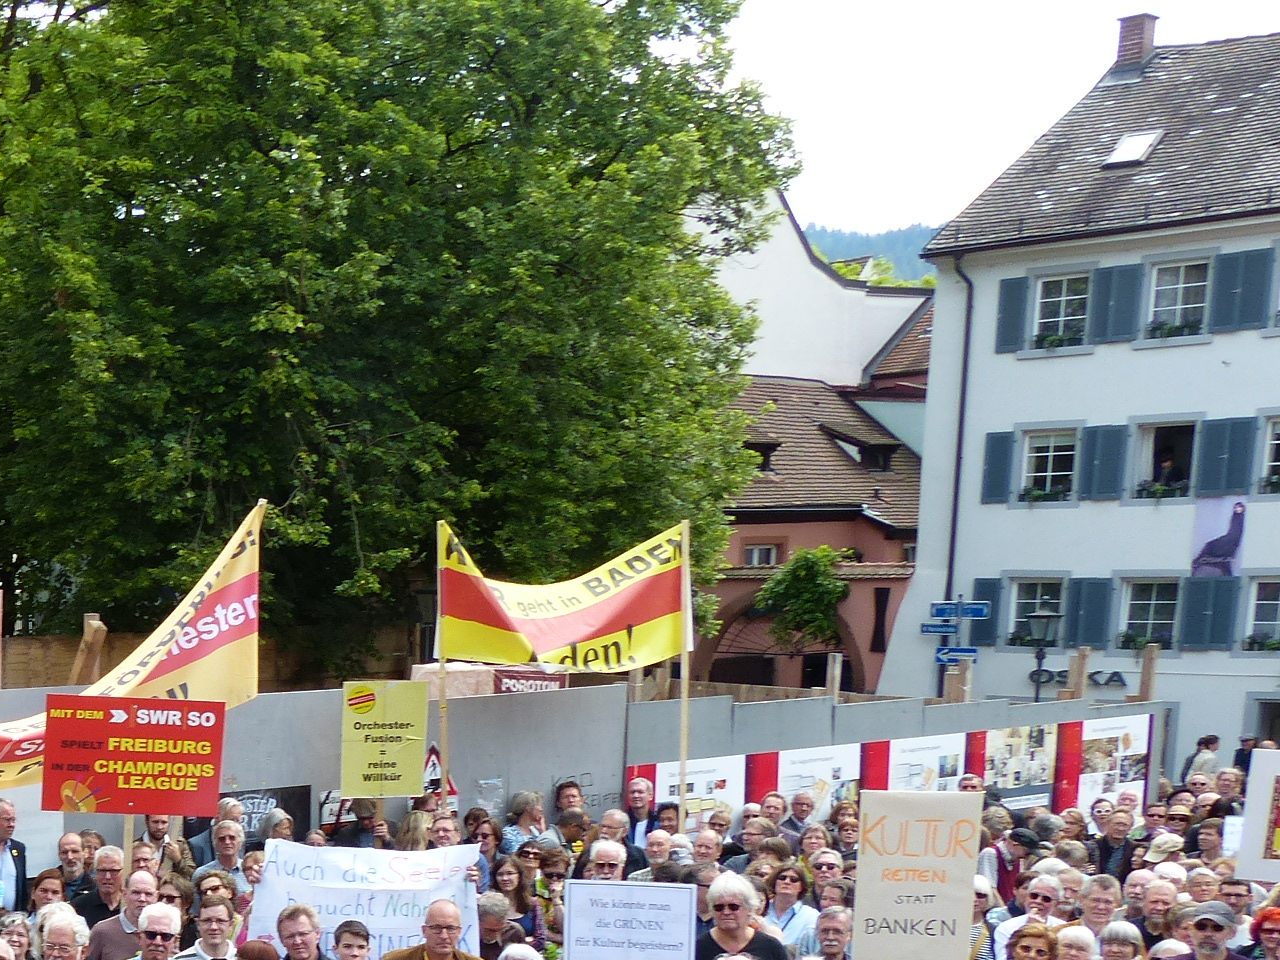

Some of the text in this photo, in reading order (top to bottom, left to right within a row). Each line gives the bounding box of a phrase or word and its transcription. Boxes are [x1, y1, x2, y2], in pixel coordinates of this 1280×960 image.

[516, 599, 556, 617] geht
[561, 593, 582, 608] in
[50, 708, 216, 727] MIT DEM SWR SO
[353, 721, 415, 731] Orchester-
[60, 737, 212, 755] SPIELT FREIBURG
[364, 734, 403, 743] Fusion
[51, 763, 64, 771] IN
[65, 763, 90, 771] DER
[94, 759, 215, 778] CHAMPIONS
[368, 760, 397, 769] reine
[117, 774, 199, 791] LEAGUE
[362, 772, 402, 782] Willkür
[860, 812, 977, 859] KULTUR
[263, 844, 325, 882] Auch
[342, 850, 377, 885] die
[881, 868, 948, 884] RETTEN
[589, 897, 671, 912] Wie könnte man
[894, 894, 937, 905] STATT
[595, 917, 665, 931] die GRÜNEN
[864, 917, 957, 937] BANKEN
[575, 937, 590, 947] für
[592, 937, 626, 949] Kultur
